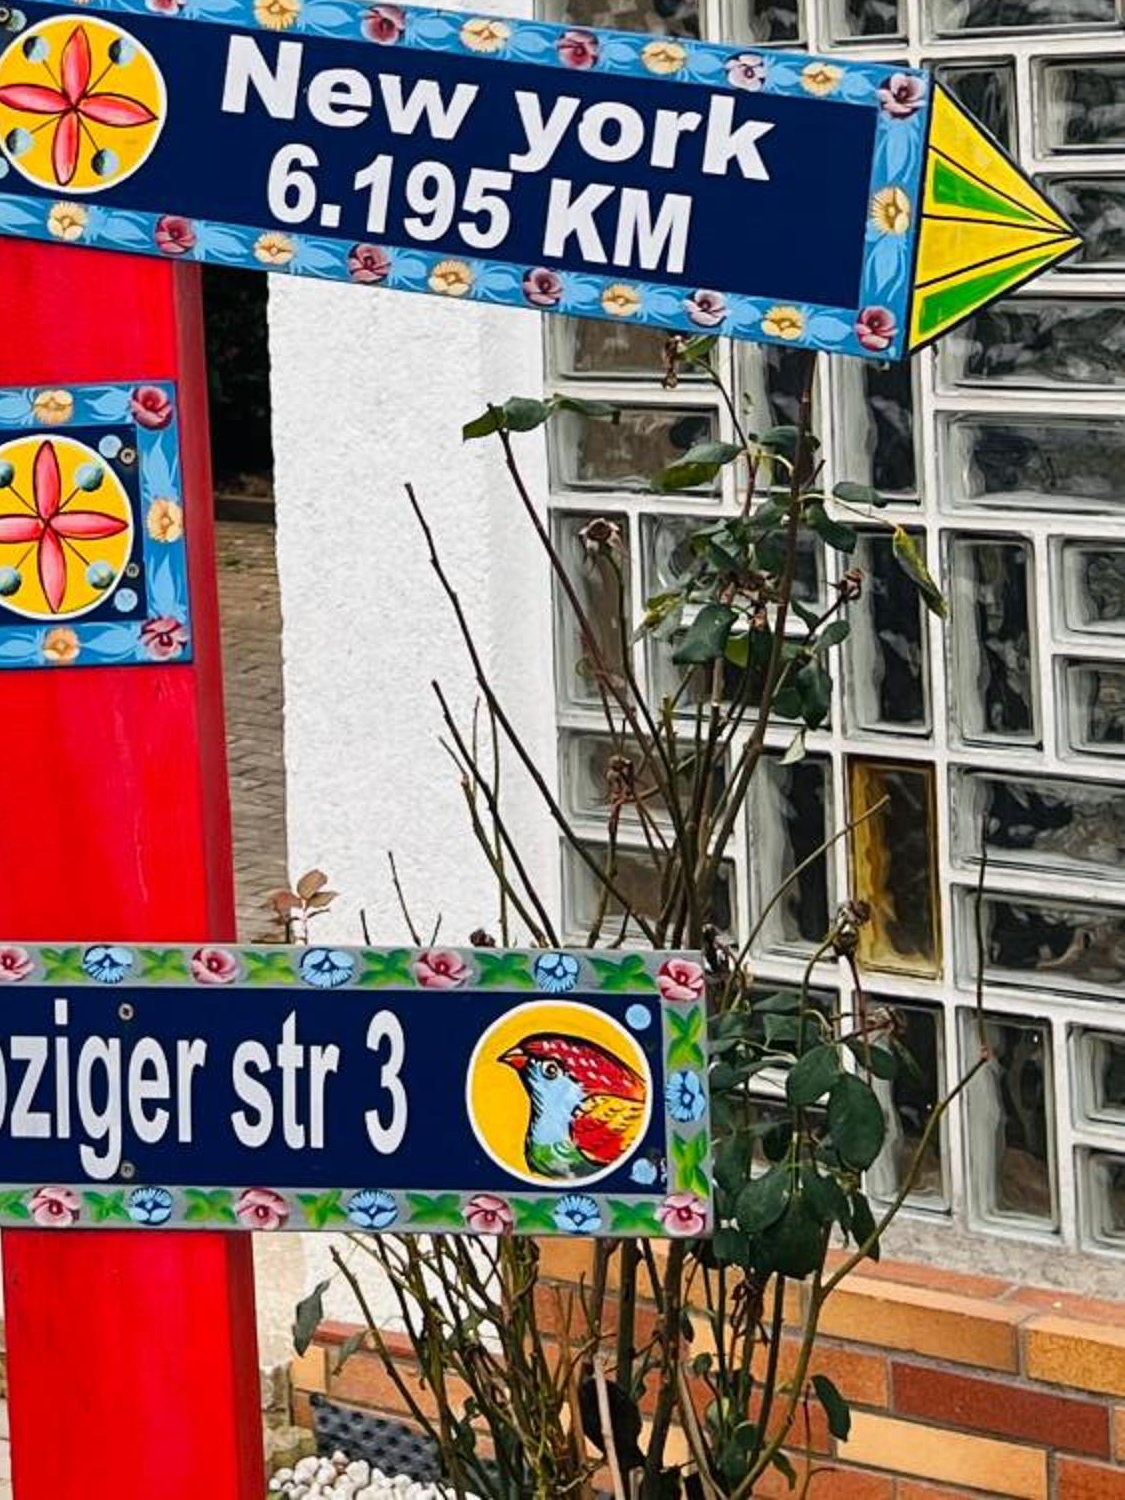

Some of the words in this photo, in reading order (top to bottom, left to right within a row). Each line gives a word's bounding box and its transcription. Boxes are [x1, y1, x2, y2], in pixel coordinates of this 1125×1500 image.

[221, 34, 479, 140] New
[509, 91, 775, 181] york
[268, 143, 513, 249] 6.195
[543, 178, 692, 273] KM
[231, 1011, 340, 1149] str
[365, 1010, 407, 1154] 3
